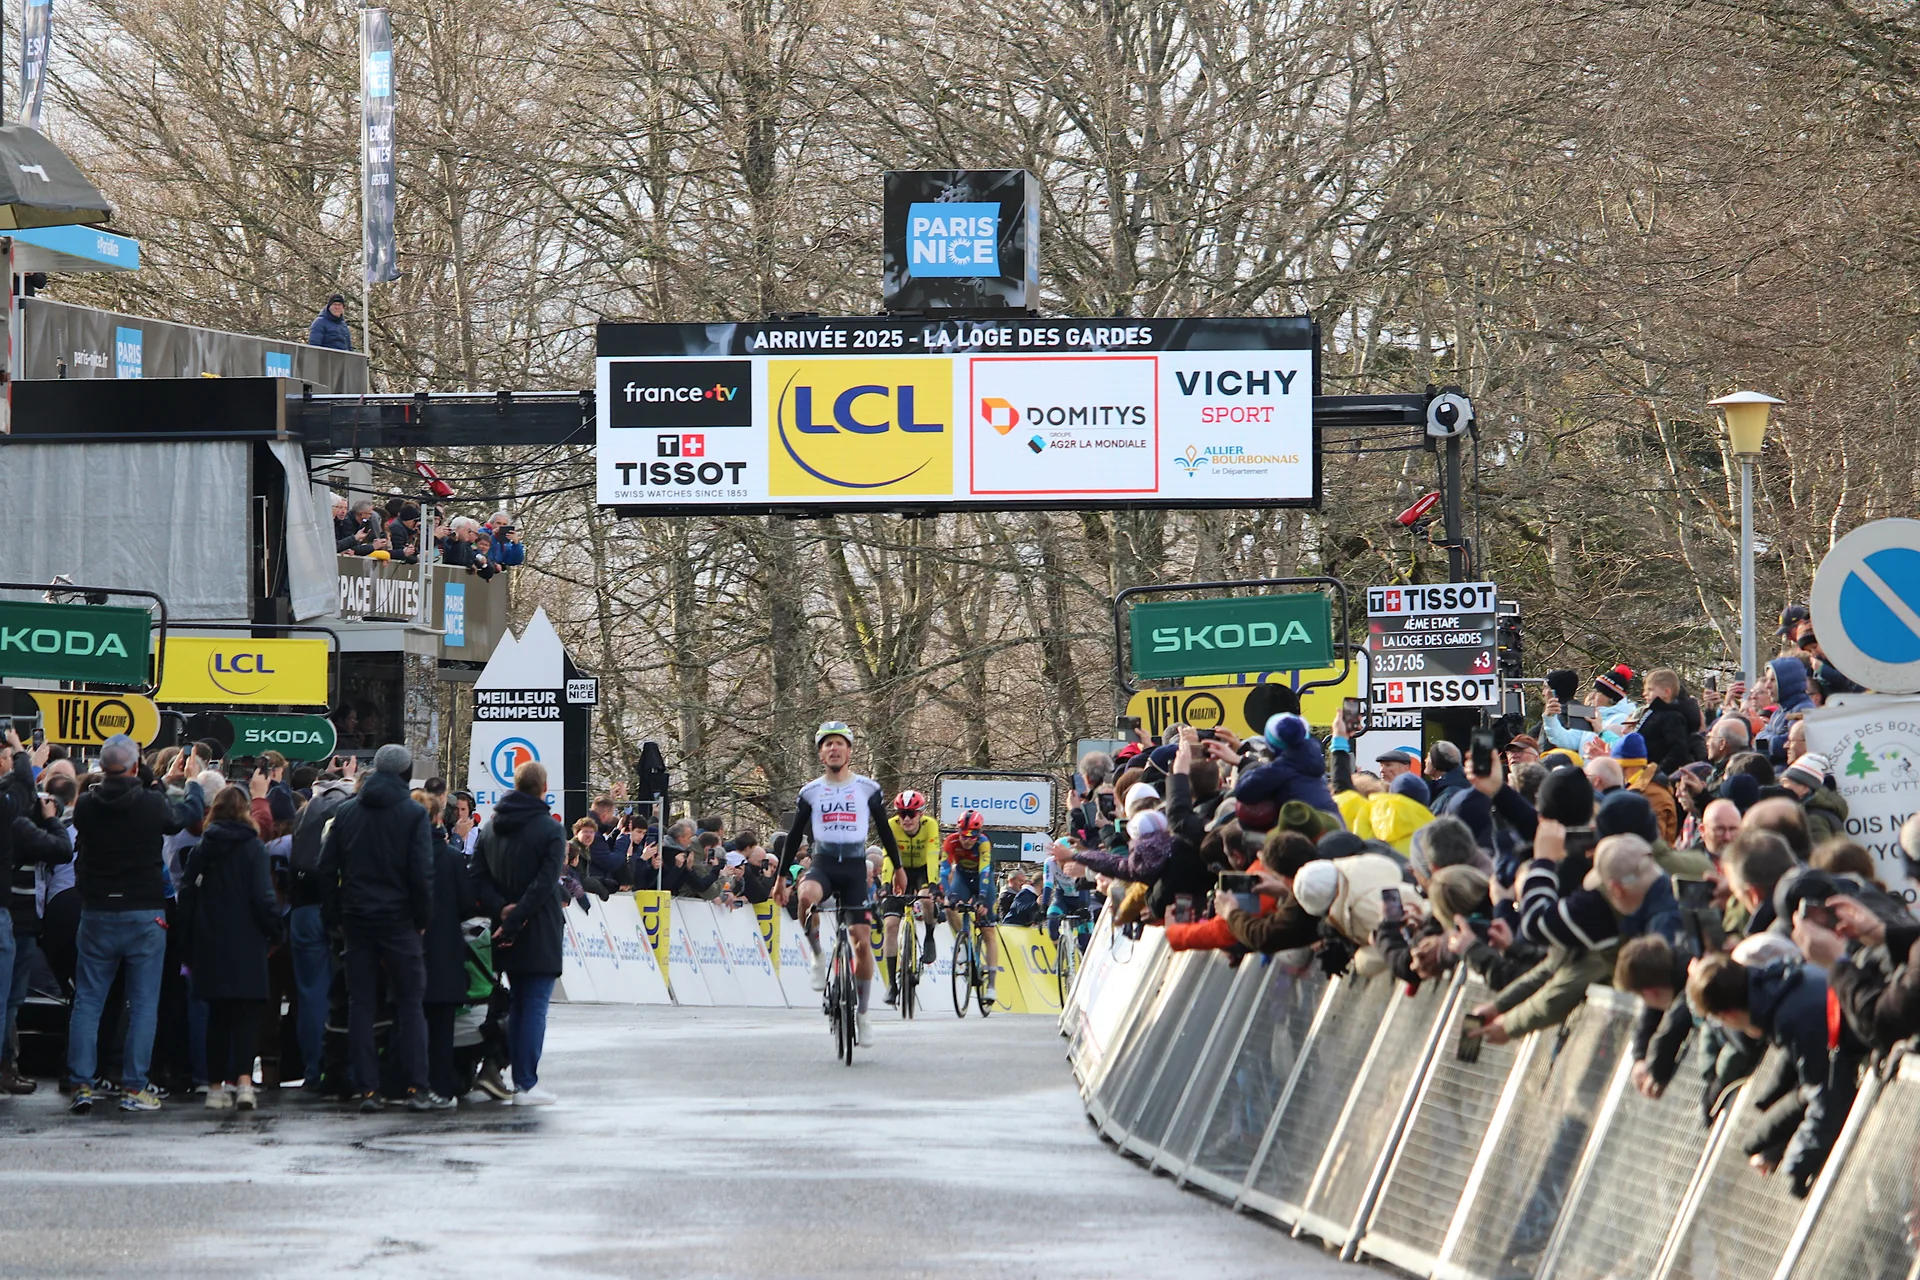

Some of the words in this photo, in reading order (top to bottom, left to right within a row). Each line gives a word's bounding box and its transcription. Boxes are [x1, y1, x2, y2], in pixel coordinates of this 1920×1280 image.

[913, 217, 994, 237] PARIS
[913, 238, 994, 265] NICE
[753, 325, 847, 349] ARRIVÉE
[852, 330, 903, 348] 2025
[923, 329, 952, 348] LA
[957, 329, 1012, 347] LOGE
[1018, 328, 1060, 347] DES
[1065, 327, 1153, 346] GARDES
[73, 349, 108, 369] paris-nice.fr
[117, 342, 141, 364] PARIS
[1175, 370, 1298, 396] VICHY
[795, 385, 944, 434] LCL
[1027, 406, 1147, 426] DOMITYS
[1201, 406, 1275, 423] SPORT
[1050, 440, 1077, 449] AG2R
[1079, 440, 1092, 448] LA
[1095, 439, 1147, 448] MONDIALE
[1204, 446, 1244, 455] ALLIER
[1212, 454, 1299, 465] BOURBONNAIS
[615, 462, 747, 486] TISSOT
[1222, 467, 1268, 476] Département
[614, 490, 645, 498] SWISS
[647, 490, 692, 498] WATCHES
[695, 489, 724, 498] SINCE
[727, 489, 748, 497] 1853
[338, 575, 371, 612] PACE
[375, 569, 419, 616] INVITÉS
[1404, 586, 1493, 611] TISSOT
[444, 595, 464, 613] PARIS
[445, 613, 464, 635] NICE
[1403, 615, 1429, 630] 4ÈME
[1431, 616, 1460, 630] ETAPE
[0, 627, 128, 658] KODA
[1382, 636, 1396, 648] LA
[1397, 635, 1422, 647] LOGE
[1424, 634, 1442, 646] DES
[1444, 632, 1482, 646] GARDES
[215, 653, 275, 673] LCL
[1374, 653, 1425, 672] 3:37:05
[1473, 651, 1491, 668] +3
[477, 691, 557, 705] MEILLEUR
[568, 691, 594, 699] NICE
[1406, 679, 1495, 702] TISSOT
[477, 706, 560, 719] GRIMPEUR
[1189, 707, 1218, 720] MAGAZINE
[98, 715, 128, 728] MAGAZINE
[1360, 715, 1422, 728] RIMPE
[1854, 722, 1884, 738] DES
[1892, 781, 1919, 791] VTT
[821, 801, 856, 813] UAE
[951, 796, 1018, 810] E.Leclerc
[1845, 816, 1883, 835] OIS
[1032, 843, 1044, 852] ici
[643, 896, 660, 950] LCL
